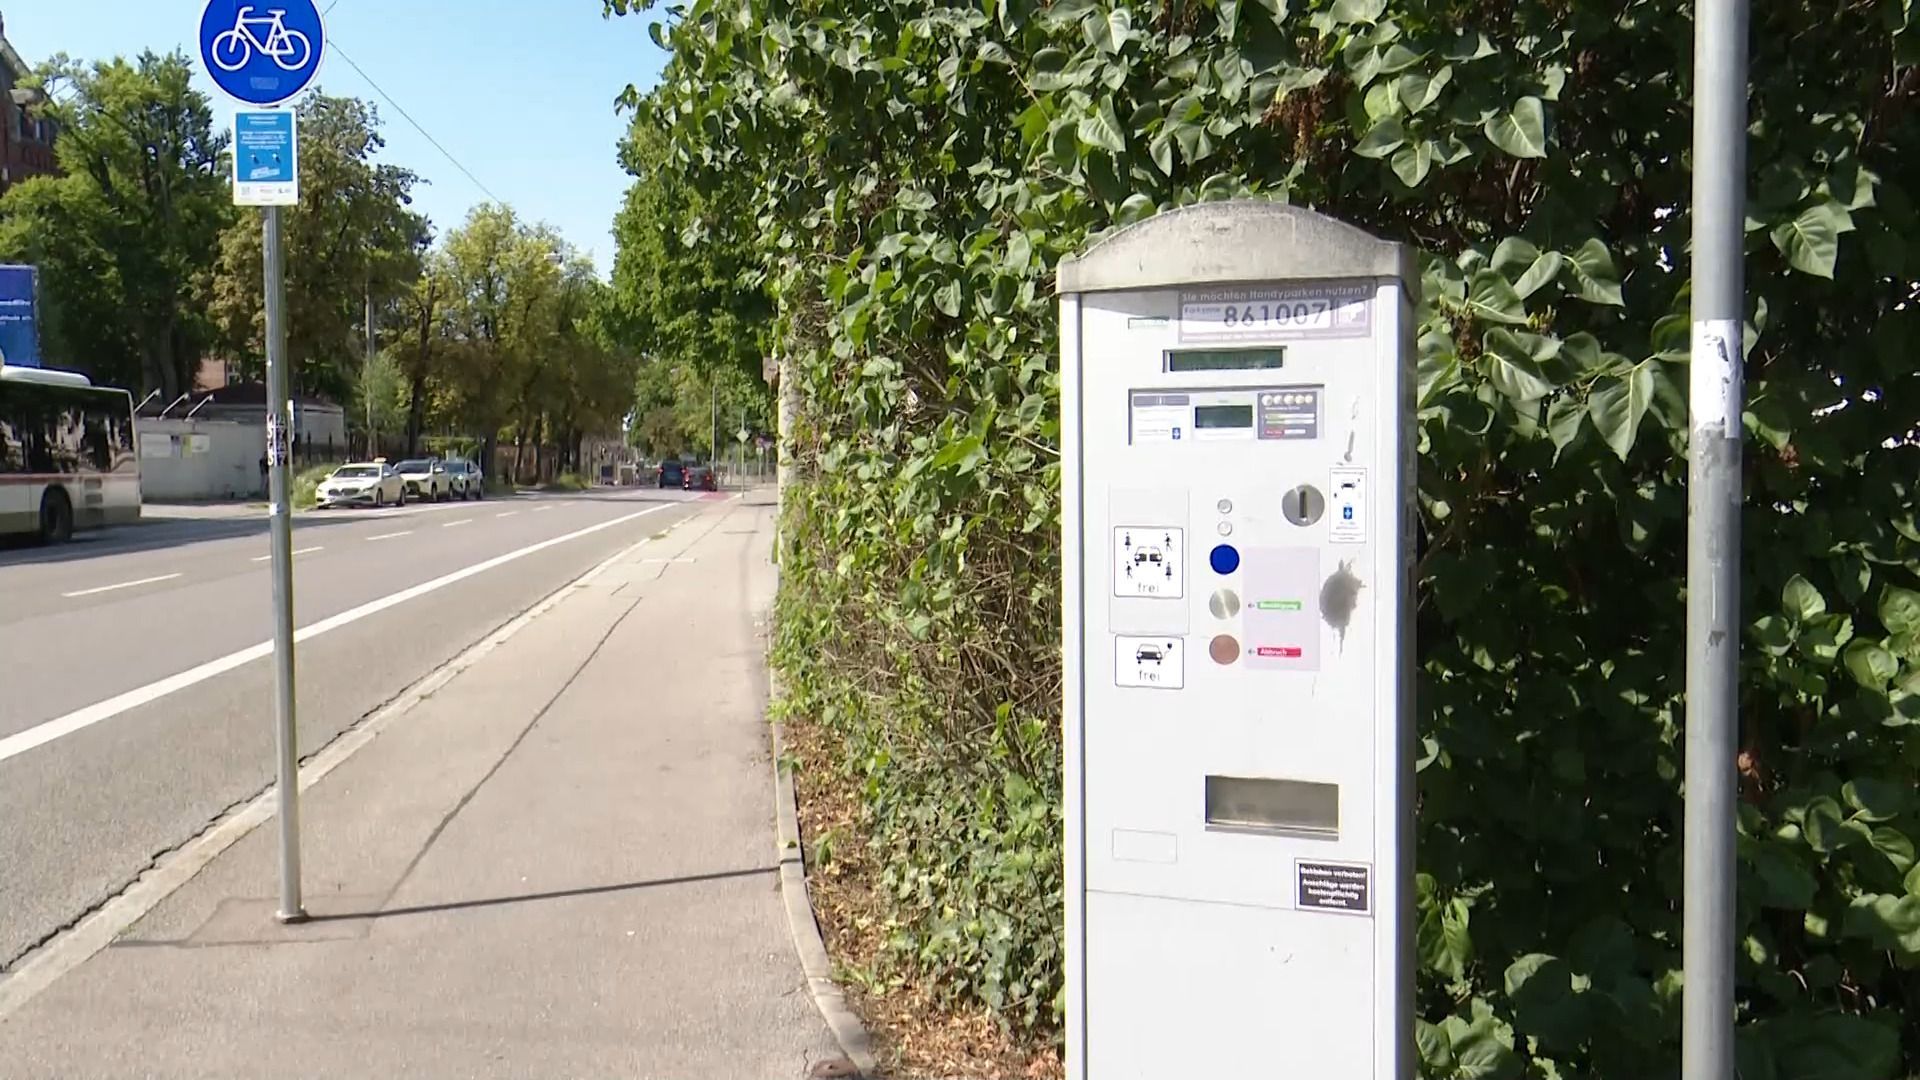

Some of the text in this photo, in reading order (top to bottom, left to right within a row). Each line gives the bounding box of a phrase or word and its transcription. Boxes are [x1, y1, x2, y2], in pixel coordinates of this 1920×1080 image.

[1223, 303, 1327, 328] 861007
[1137, 582, 1160, 593] frei
[1138, 670, 1161, 682] frei
